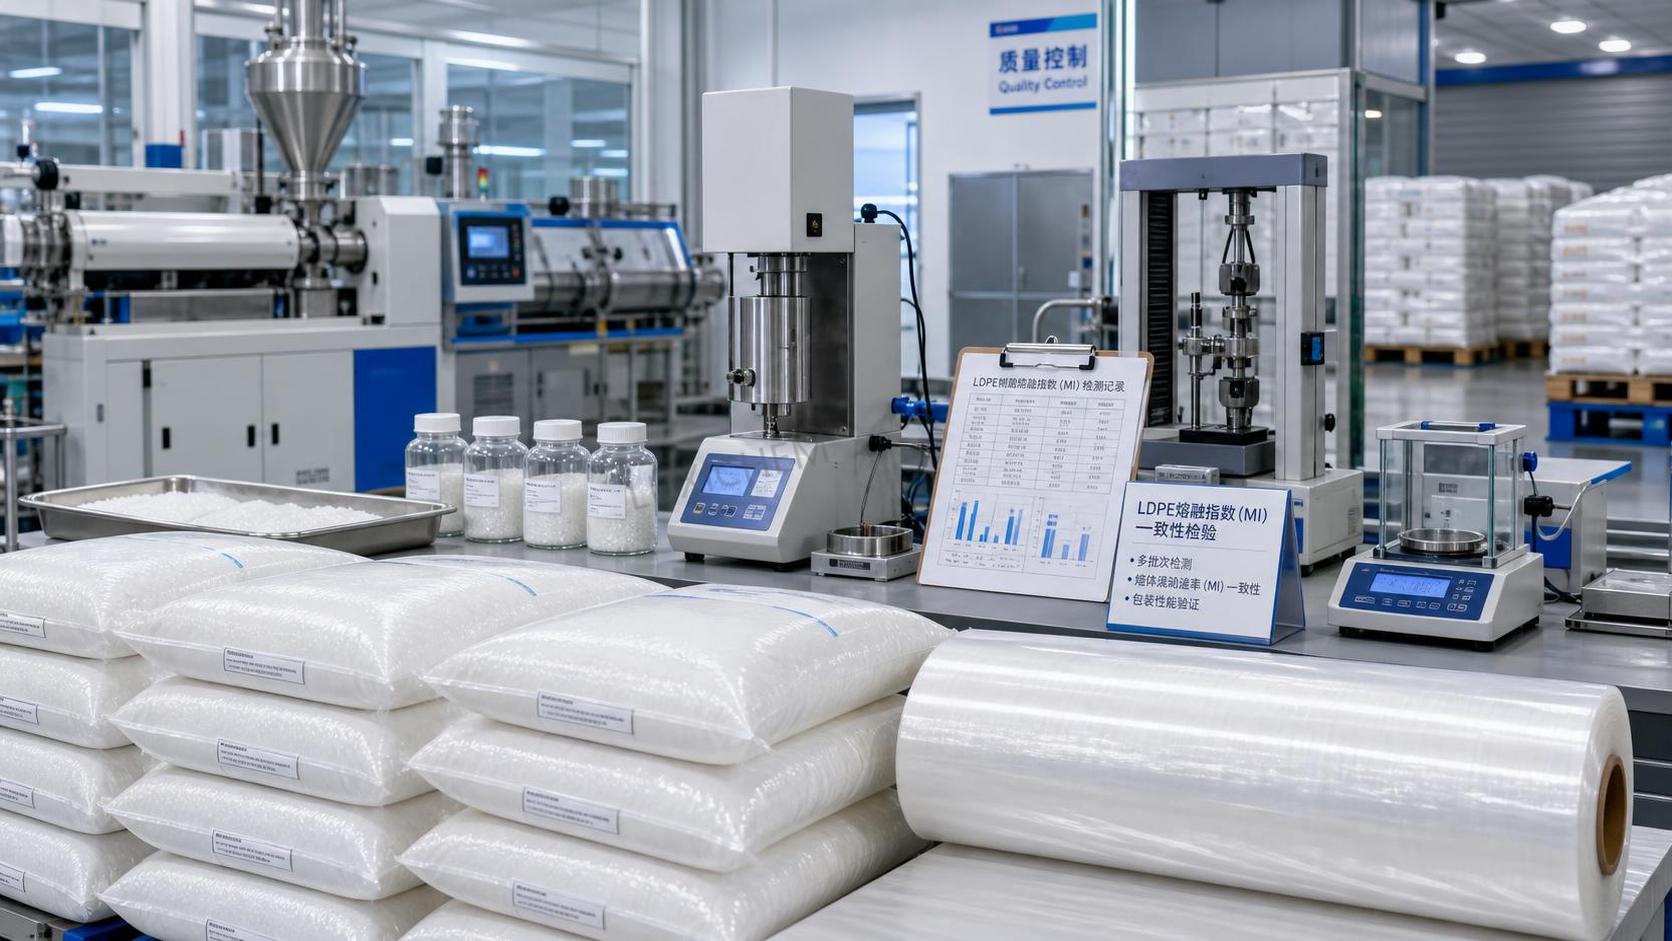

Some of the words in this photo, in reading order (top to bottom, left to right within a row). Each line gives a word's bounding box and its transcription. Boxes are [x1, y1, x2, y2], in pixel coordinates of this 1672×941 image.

[999, 44, 1087, 73] 质量控制
[999, 79, 1040, 94] Quality
[1044, 75, 1088, 90] Control
[1137, 501, 1236, 522] LDPE熔融指数
[1238, 506, 1268, 525] (MI)
[1135, 521, 1217, 541] 一致性检验
[1137, 554, 1193, 571] 多批次检测
[1226, 582, 1261, 596] 一致性
[1132, 593, 1200, 611] 包装性能验证
